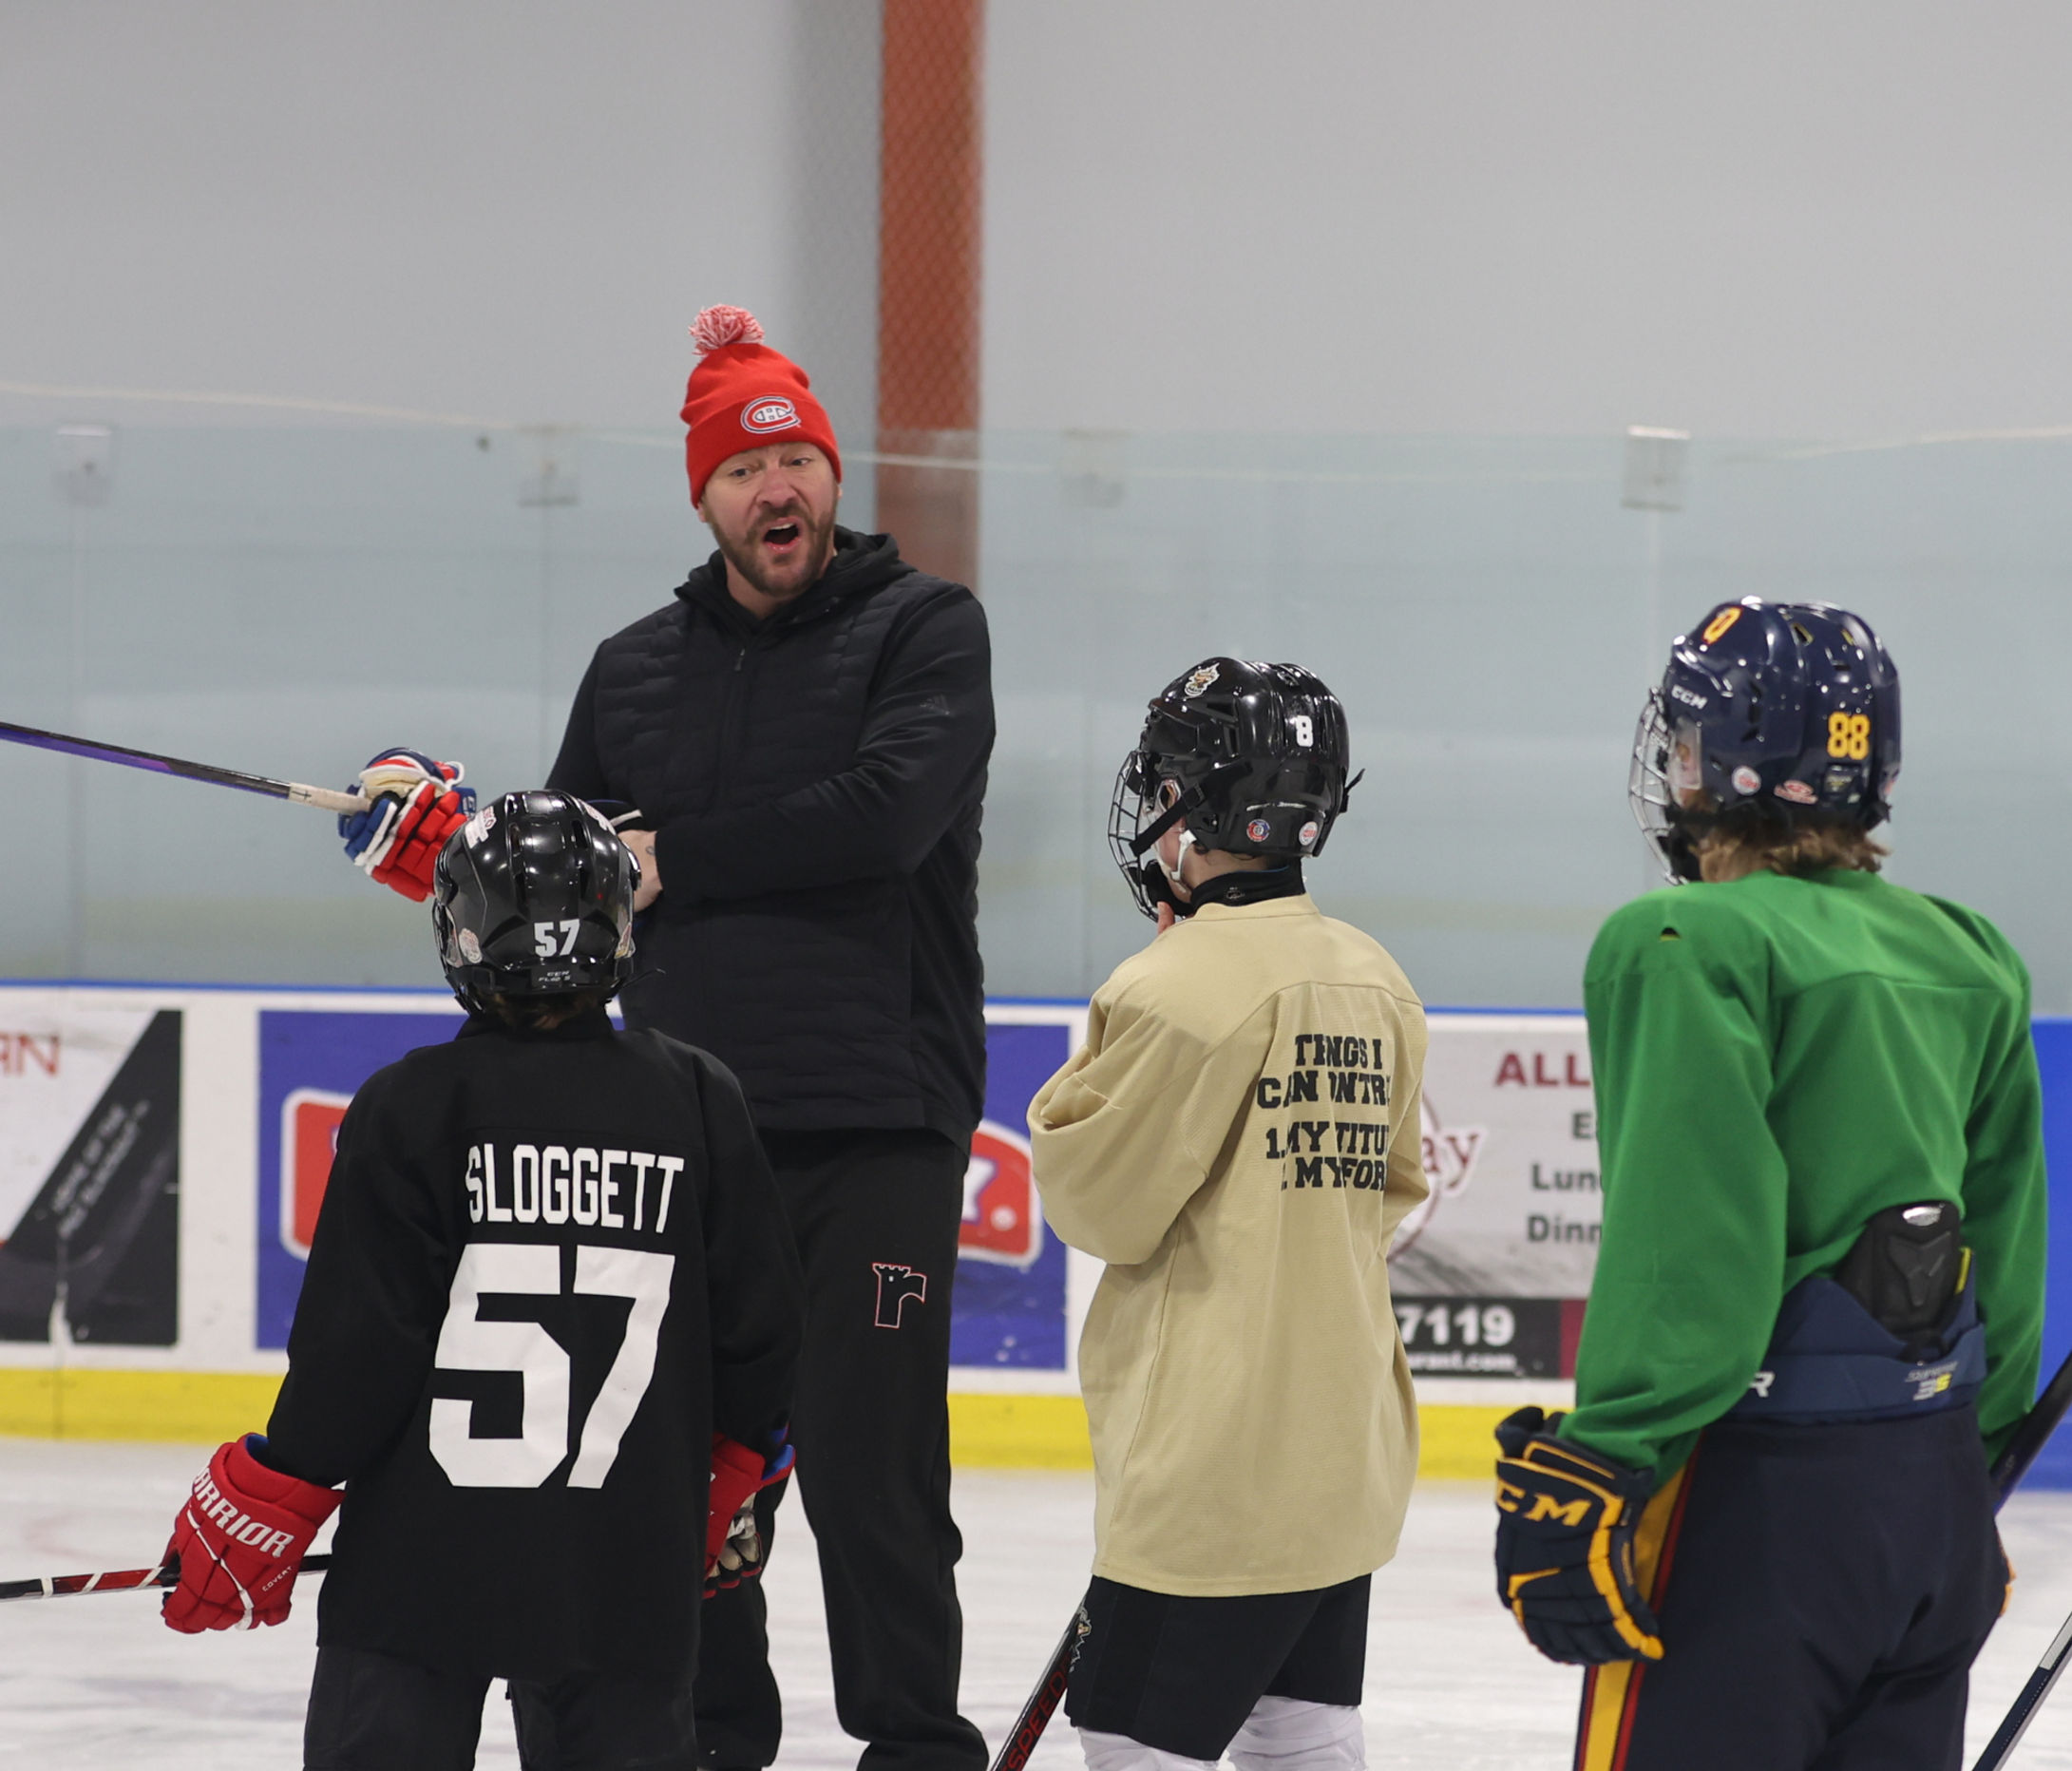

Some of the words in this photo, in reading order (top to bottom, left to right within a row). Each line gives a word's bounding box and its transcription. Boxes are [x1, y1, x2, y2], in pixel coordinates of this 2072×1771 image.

[1671, 685, 1707, 710] CCM
[1295, 715, 1314, 747] 8
[1827, 712, 1871, 760] 88
[533, 918, 580, 958] 57
[1372, 1038, 1382, 1070] I
[465, 1143, 684, 1233] SLOGGETT
[1531, 1163, 1603, 1190] Lun
[428, 1242, 675, 1489] 57
[192, 1467, 295, 1558] ARRIOR
[1497, 1477, 1592, 1527] CM
[261, 1565, 294, 1592] COVERT
